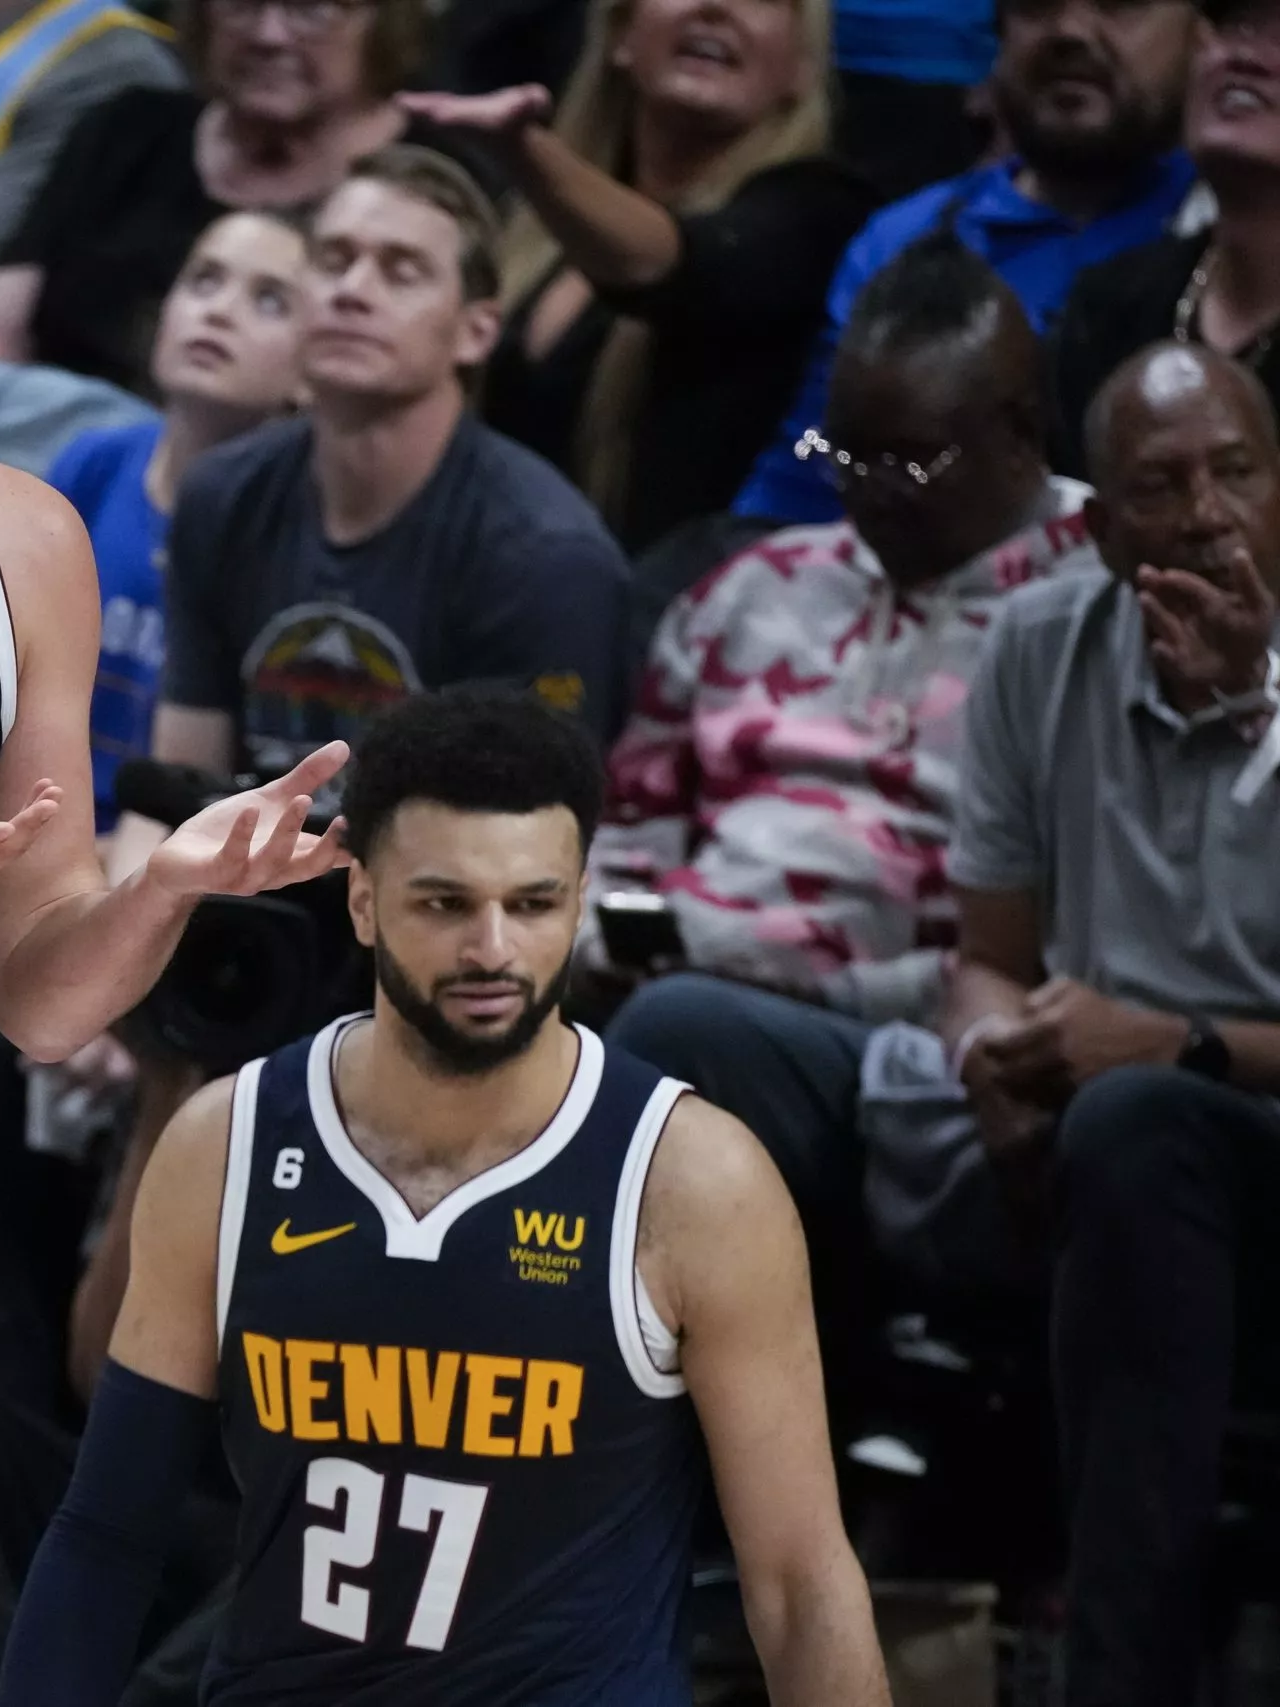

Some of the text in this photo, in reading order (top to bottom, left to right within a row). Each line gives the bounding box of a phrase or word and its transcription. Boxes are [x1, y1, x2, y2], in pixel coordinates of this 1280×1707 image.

[272, 1147, 305, 1190] 6
[513, 1206, 586, 1252] WU
[509, 1245, 582, 1271] Western
[519, 1264, 568, 1285] Union
[241, 1331, 585, 1458] DENVER
[300, 1456, 490, 1652] 27
